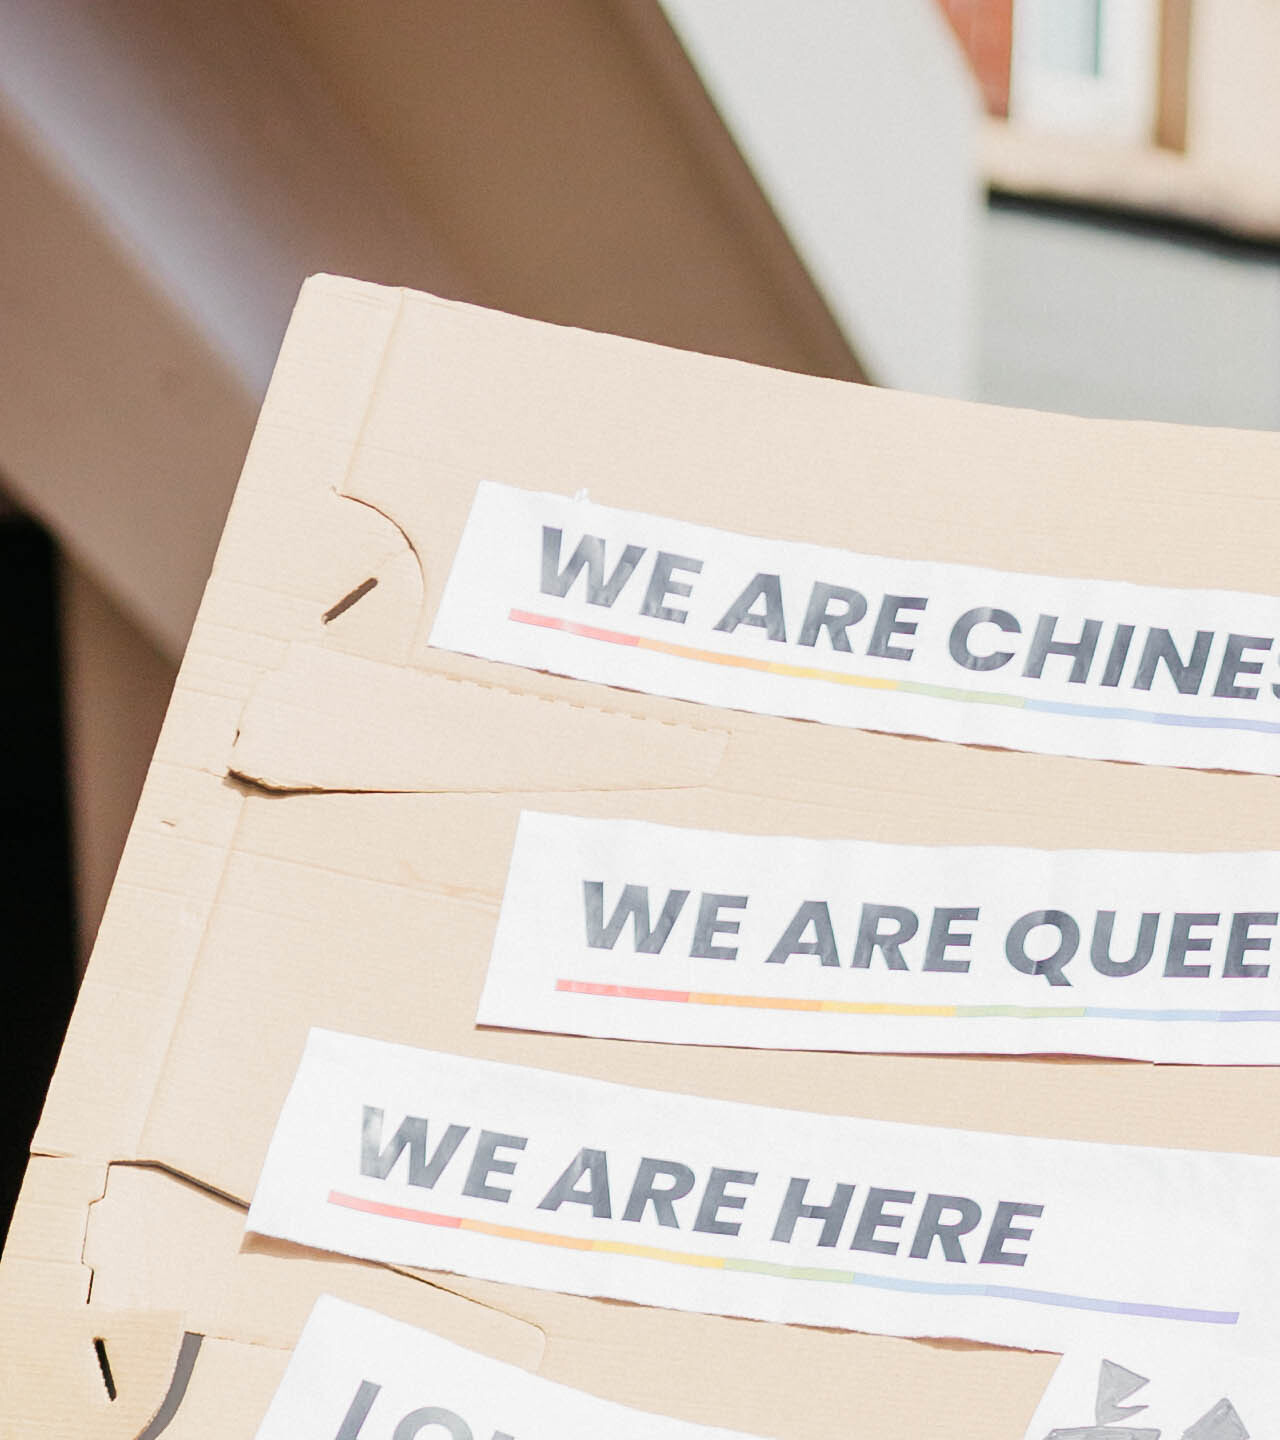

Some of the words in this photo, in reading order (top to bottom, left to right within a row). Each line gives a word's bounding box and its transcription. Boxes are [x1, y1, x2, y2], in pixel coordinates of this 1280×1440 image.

[536, 525, 703, 625] WE
[714, 570, 926, 663] ARE
[580, 880, 750, 954] WE
[766, 900, 980, 973] ARE
[358, 1104, 528, 1203] WE
[536, 1147, 757, 1237] ARE
[774, 1176, 1045, 1268] HERE
